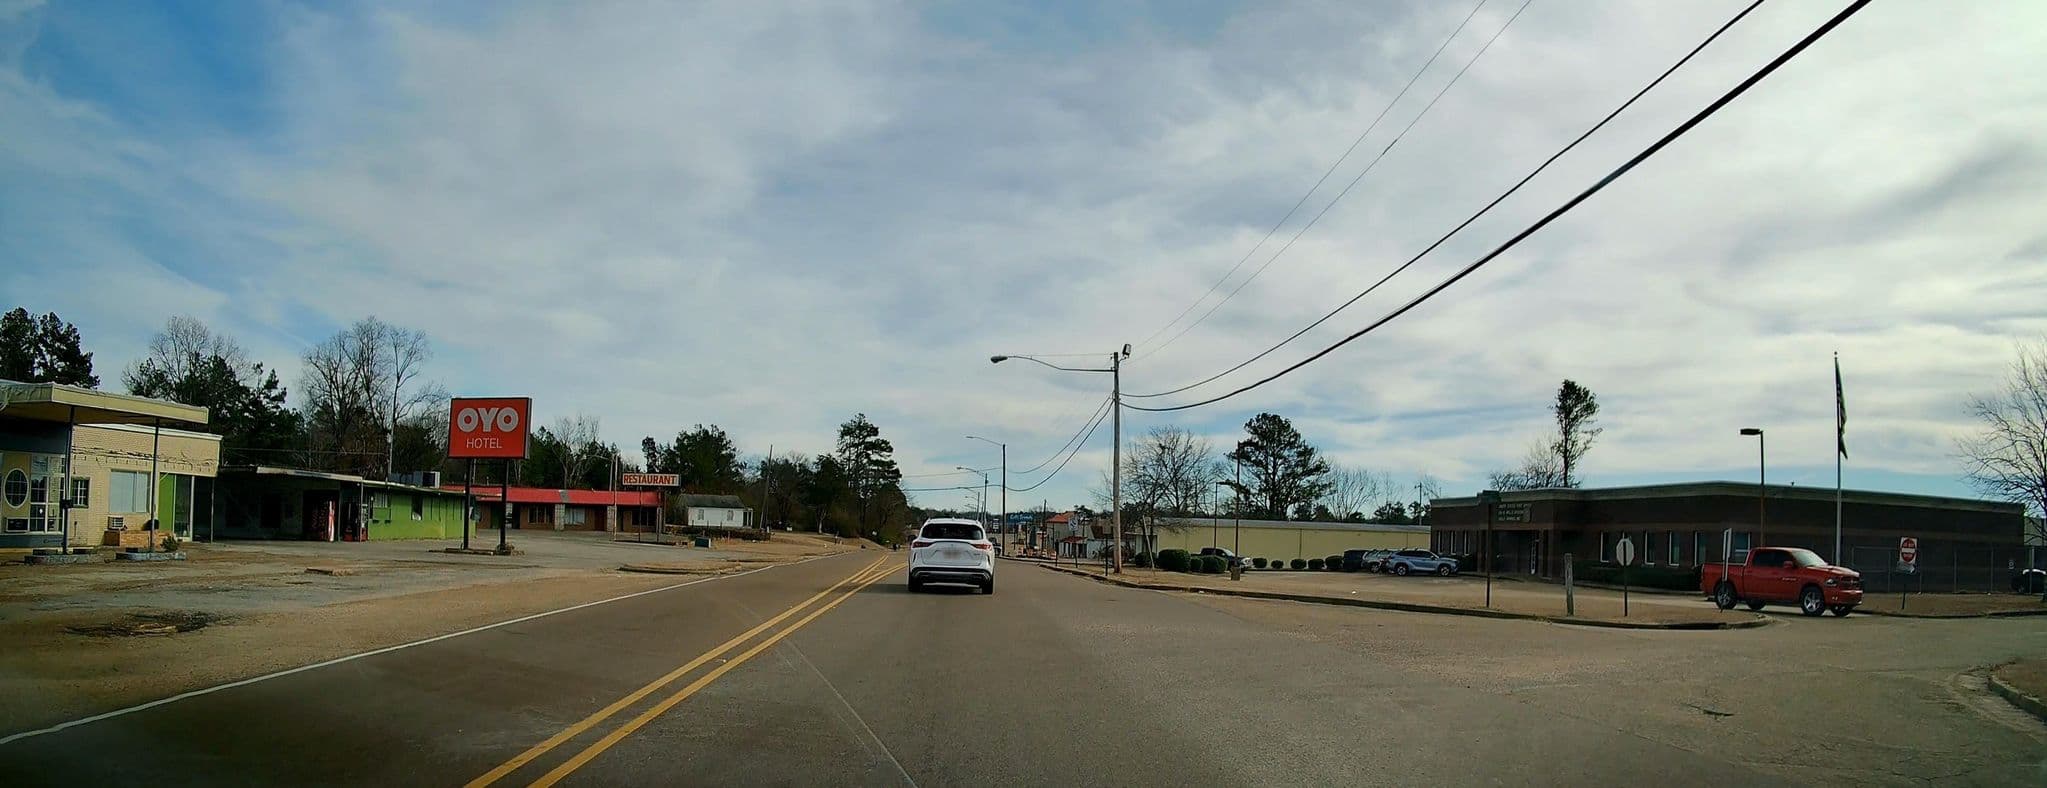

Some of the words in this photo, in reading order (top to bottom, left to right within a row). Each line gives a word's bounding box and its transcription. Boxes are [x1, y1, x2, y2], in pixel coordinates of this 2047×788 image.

[457, 407, 519, 432] OYO
[466, 438, 503, 449] HOTEL
[624, 474, 677, 485] RESTAURANT
